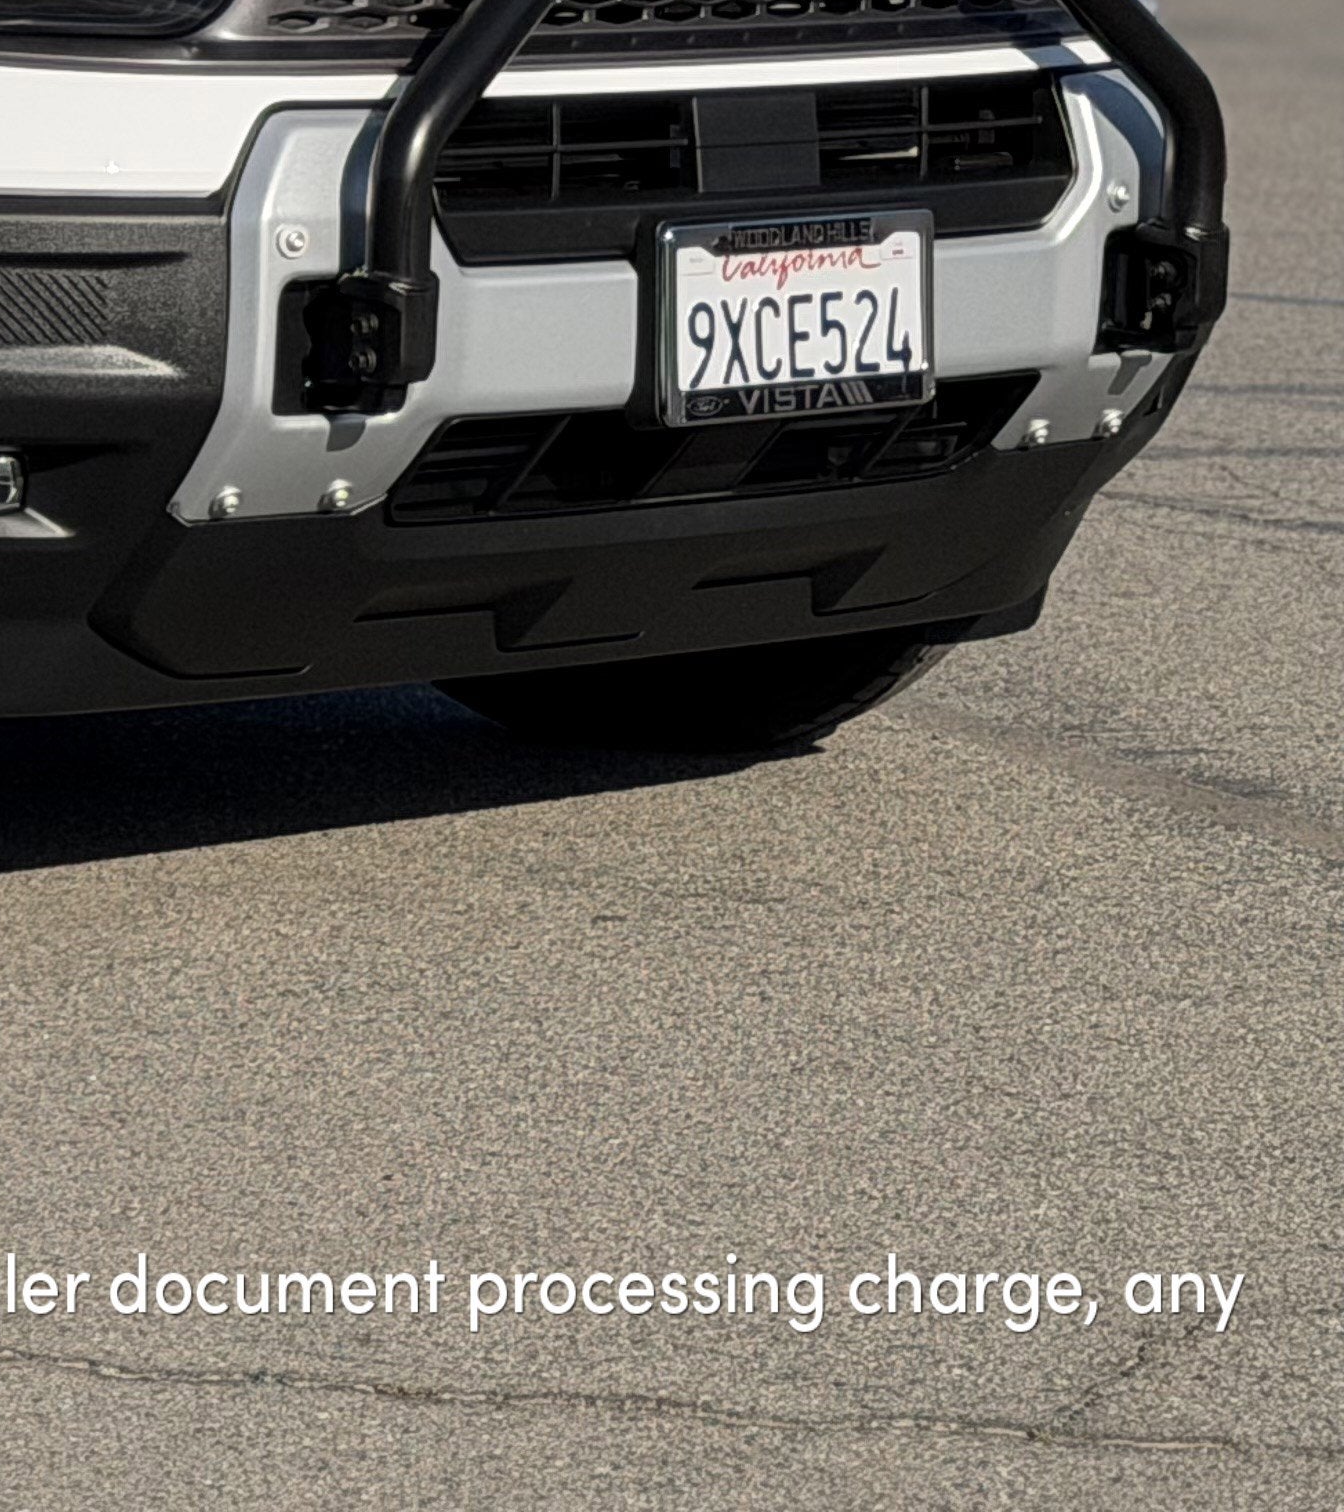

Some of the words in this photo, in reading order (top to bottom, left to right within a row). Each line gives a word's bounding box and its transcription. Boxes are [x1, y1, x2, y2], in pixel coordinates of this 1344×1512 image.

[733, 223, 824, 248] WOODLAND
[826, 221, 871, 244] HILLS
[721, 247, 882, 291] California
[687, 286, 912, 389] 9XCE524
[738, 382, 843, 415] VISTA
